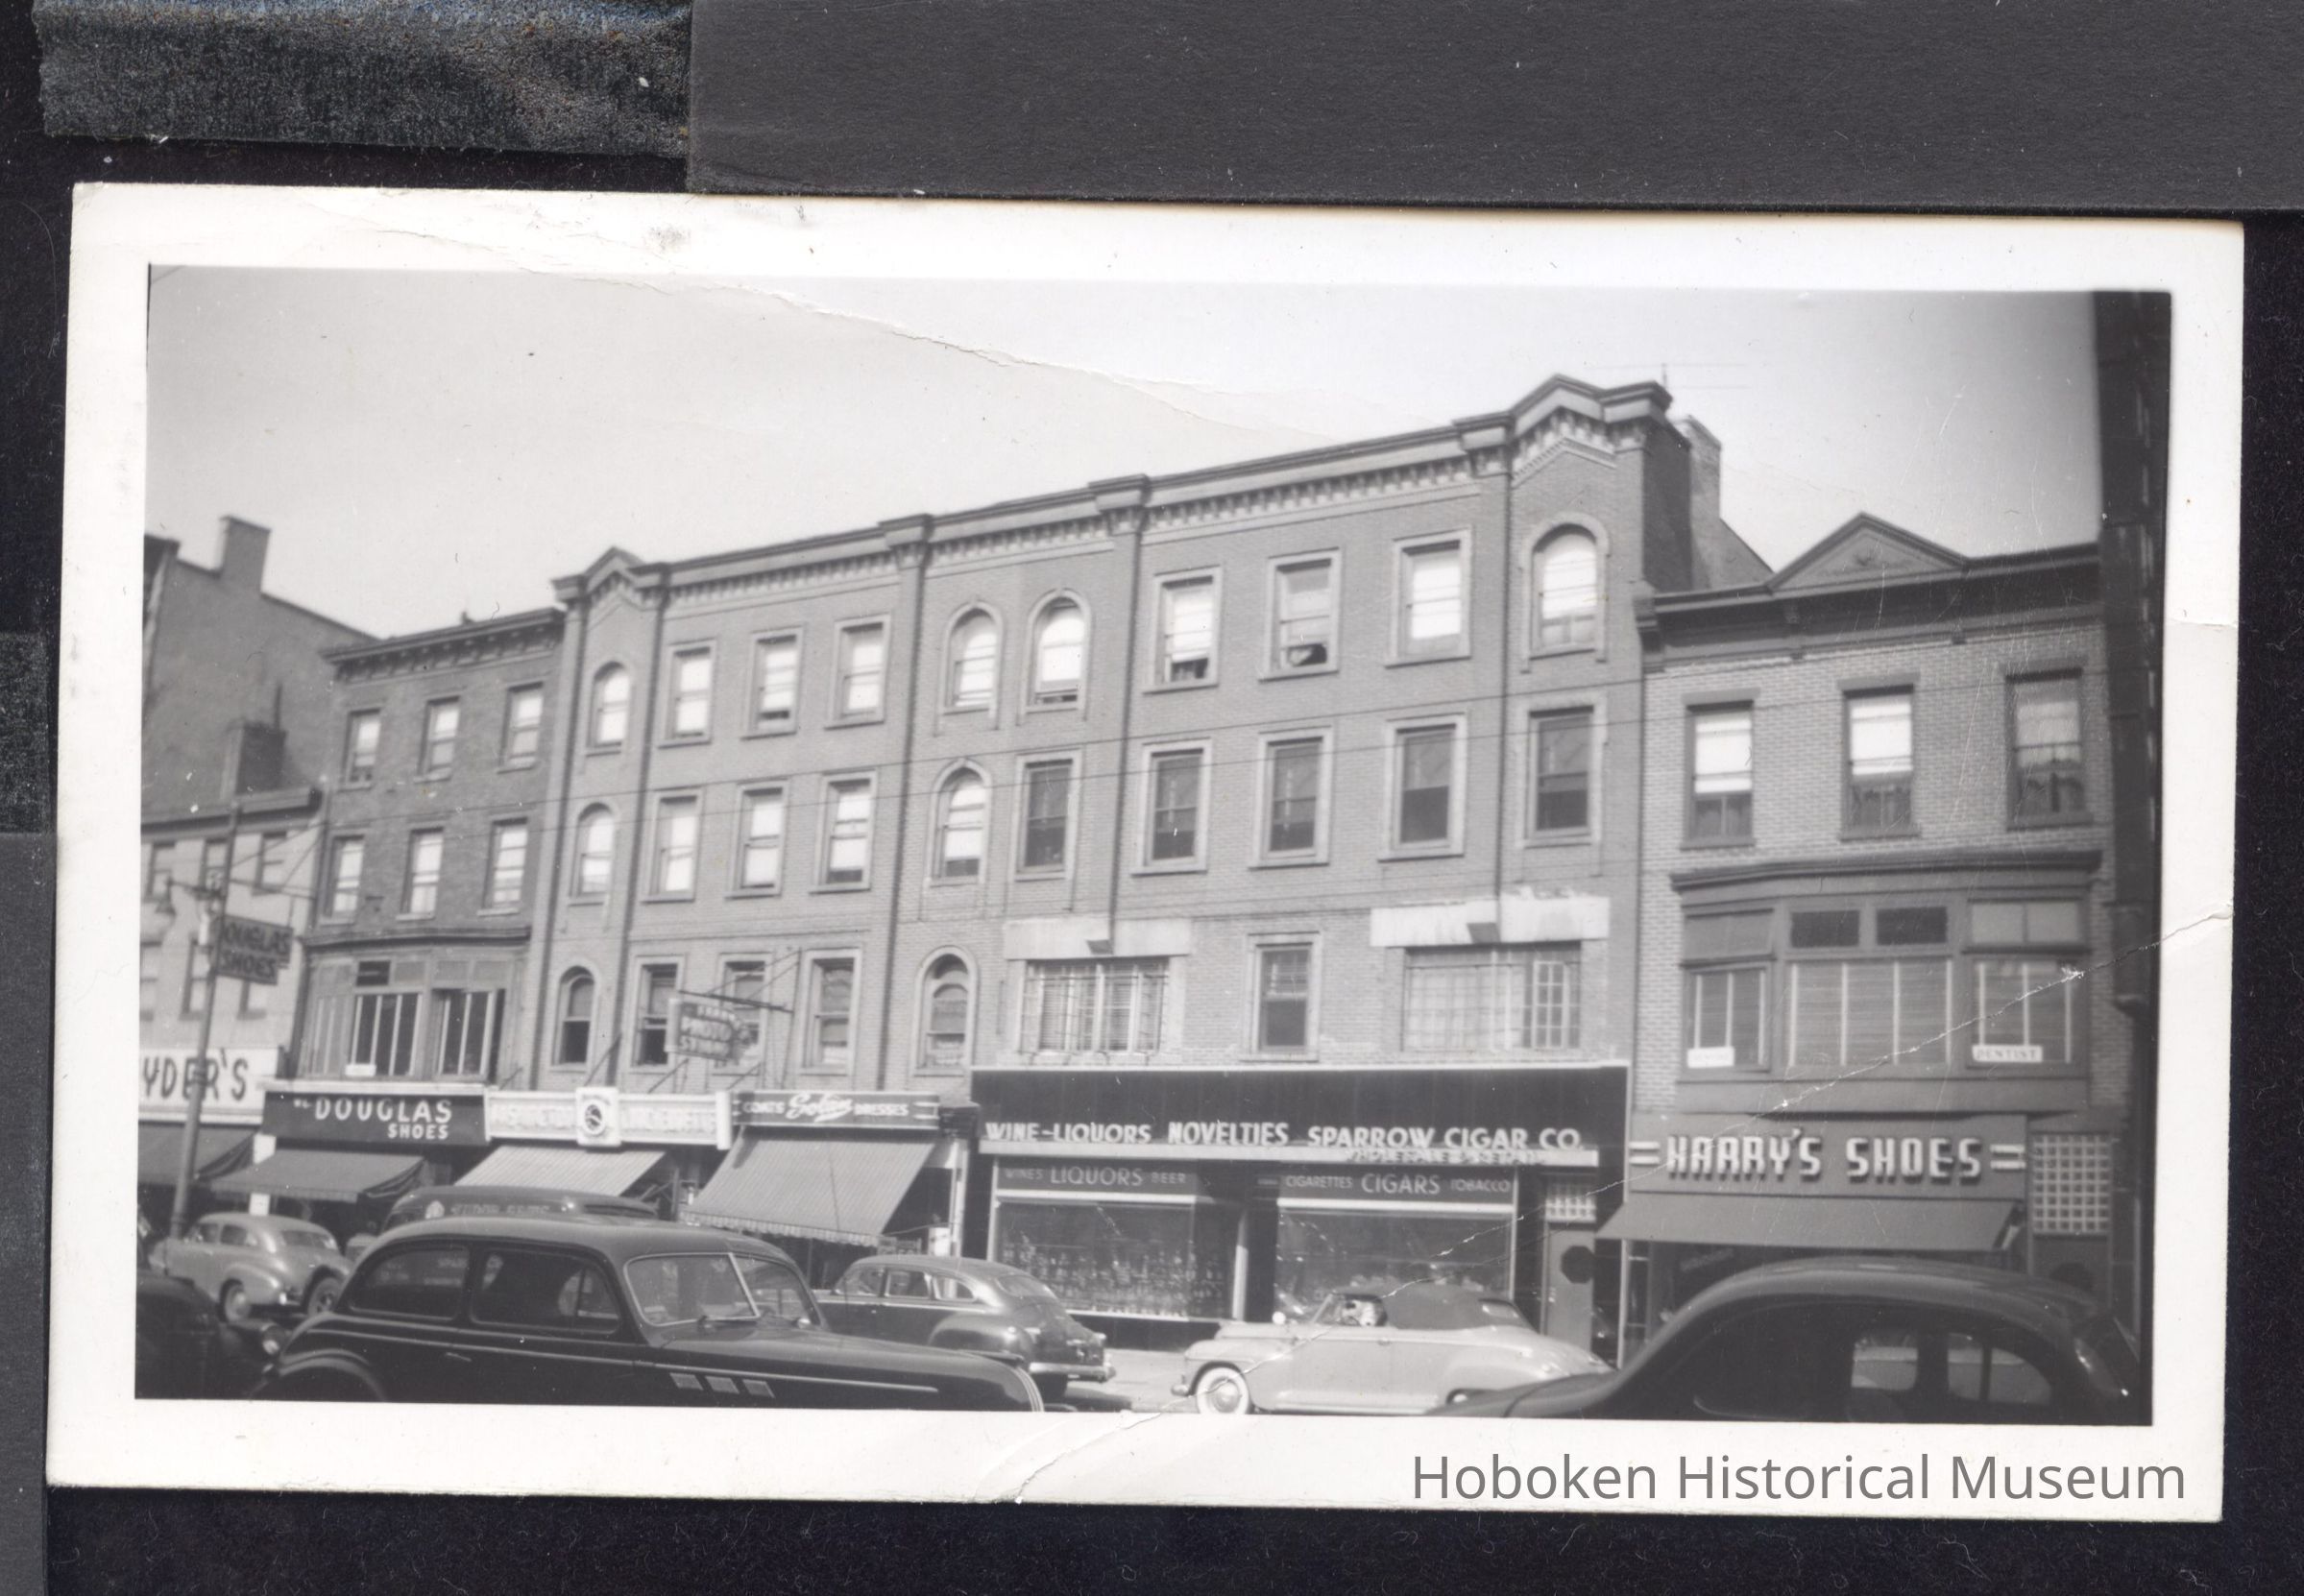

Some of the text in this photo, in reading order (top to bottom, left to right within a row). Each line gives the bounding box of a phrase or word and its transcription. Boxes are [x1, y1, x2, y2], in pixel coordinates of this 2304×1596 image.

[314, 1097, 452, 1124] DOUGLAS
[387, 1123, 449, 1141] SHOES
[1167, 1121, 1290, 1147] NOVELTIES
[1307, 1125, 1435, 1150] SPARROW
[1443, 1127, 1529, 1150] CIGAR
[1666, 1127, 1981, 1180] HARRY'S SHOES
[1050, 1166, 1145, 1187] LIQUORS
[1151, 1172, 1186, 1184] BEER
[1285, 1173, 1511, 1196] CIGARETTES CIGARS TOBACCO
